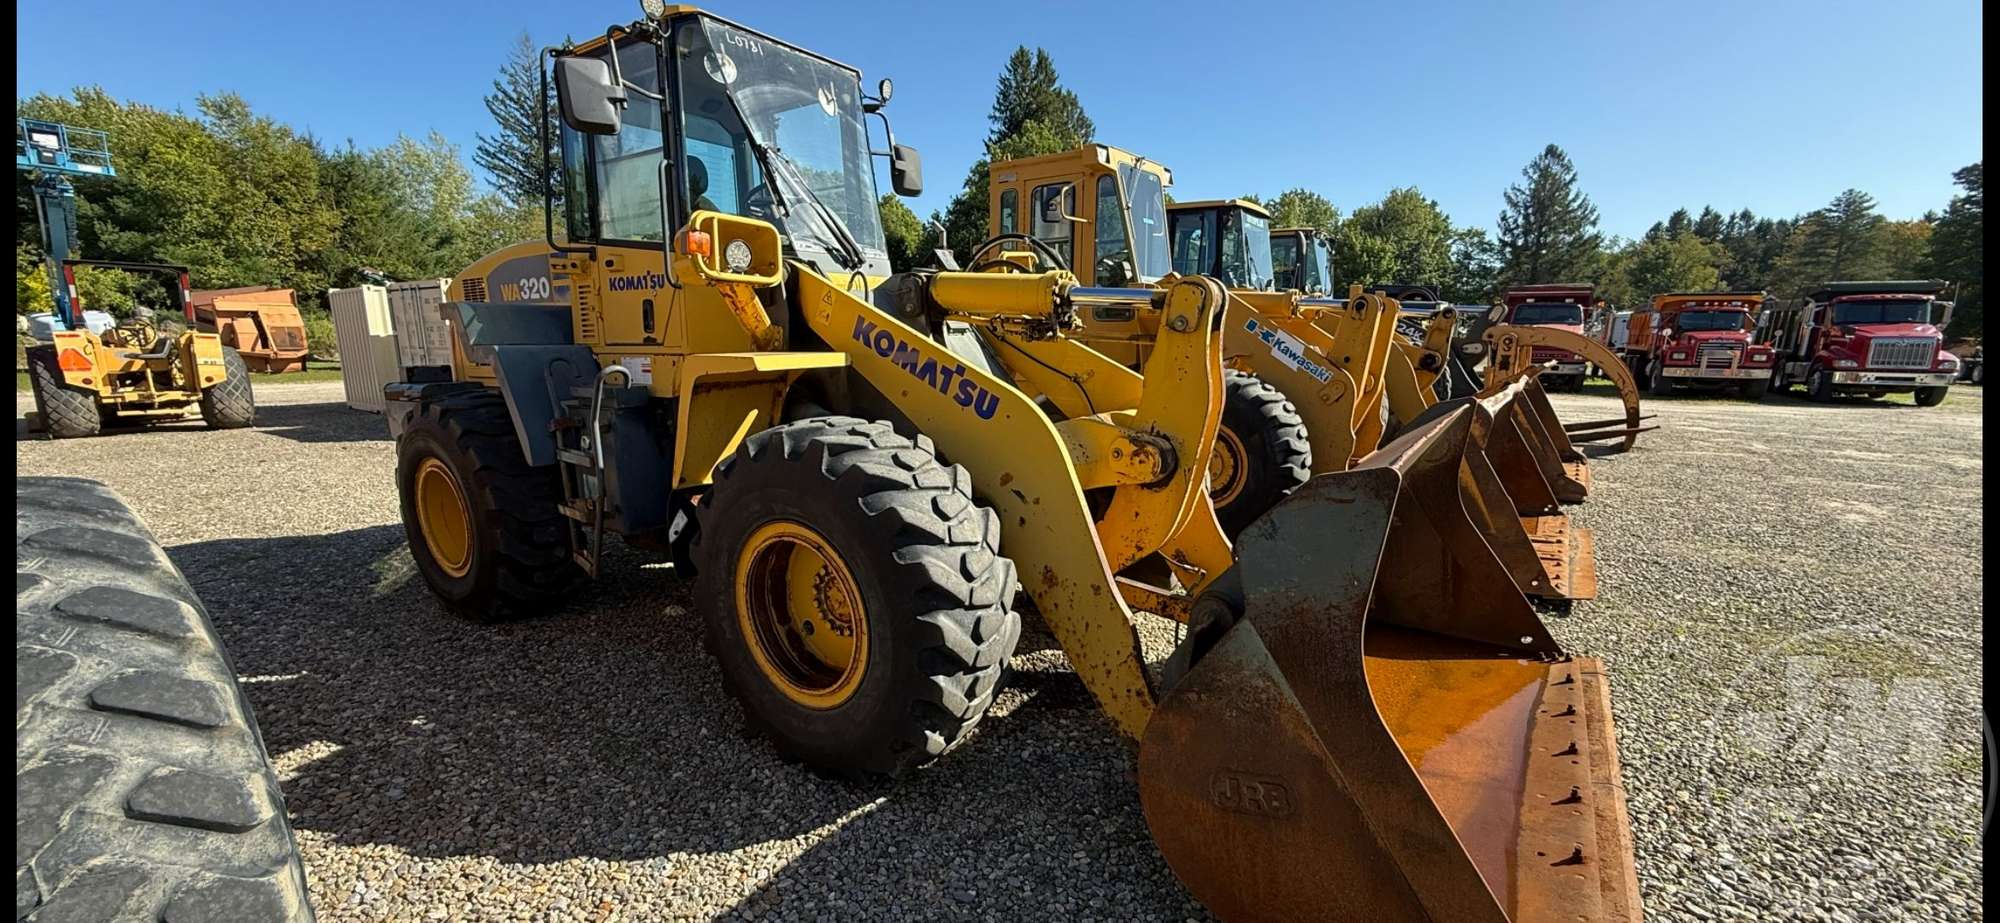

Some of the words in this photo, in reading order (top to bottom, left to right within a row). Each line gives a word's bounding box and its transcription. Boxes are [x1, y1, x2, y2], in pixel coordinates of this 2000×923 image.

[500, 276, 550, 302] WA320
[608, 270, 666, 292] KOMATSU
[852, 313, 1001, 421] KOMATSU
[1273, 337, 1333, 383] Kawasaki
